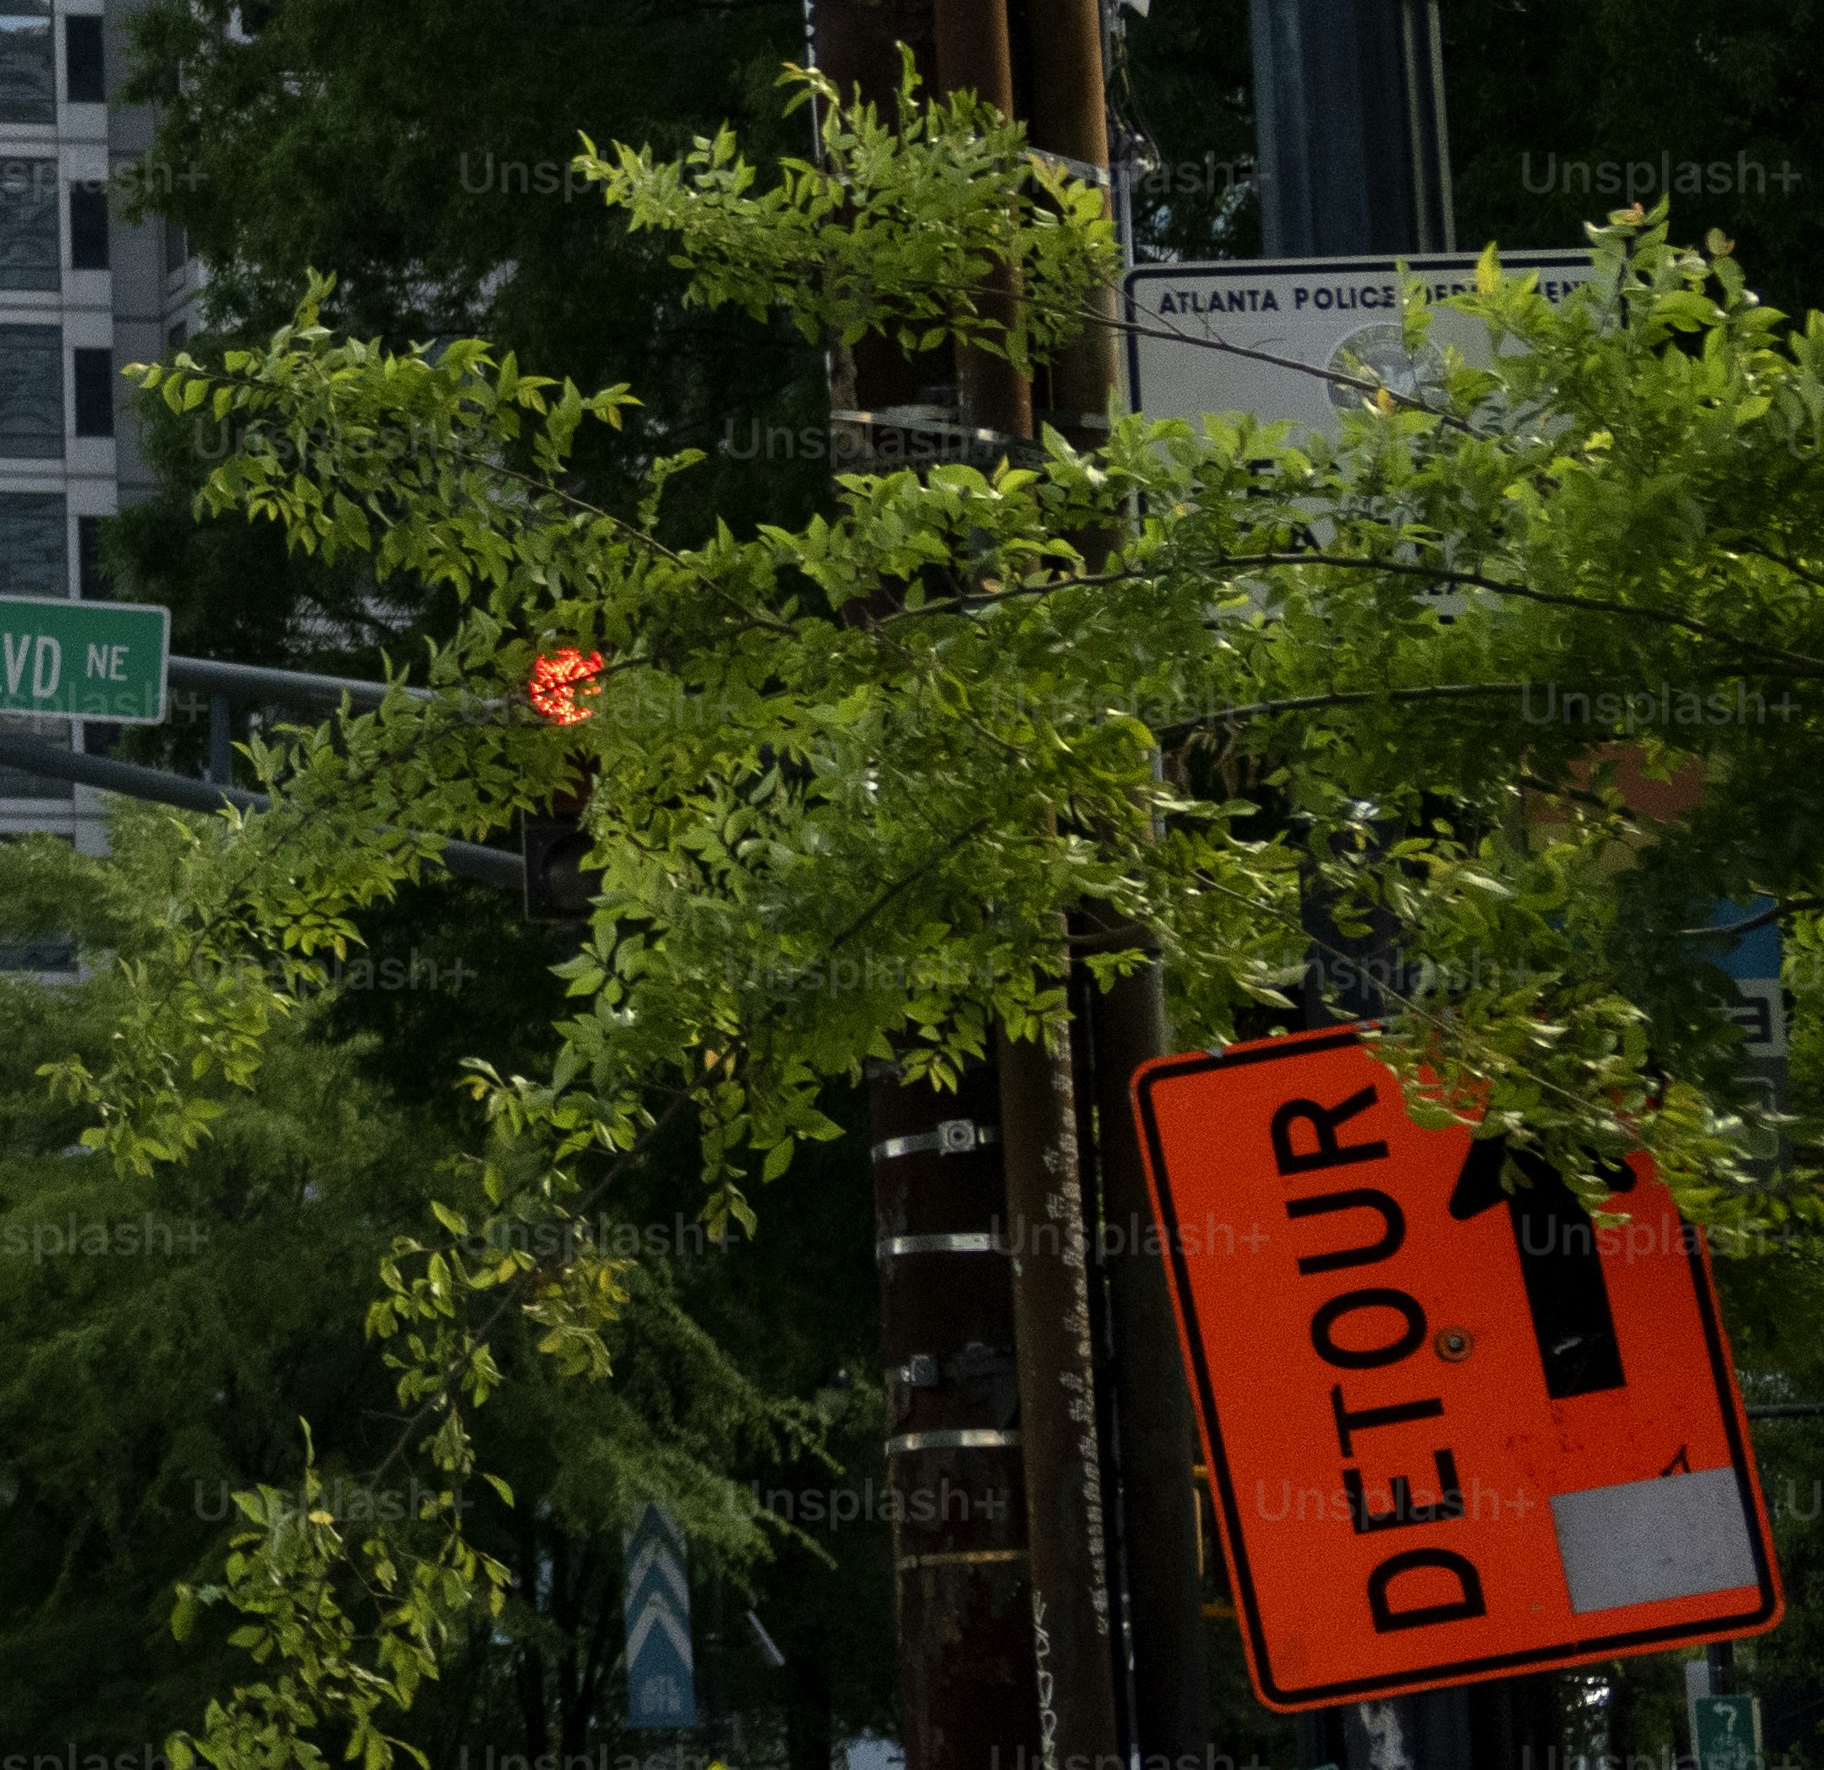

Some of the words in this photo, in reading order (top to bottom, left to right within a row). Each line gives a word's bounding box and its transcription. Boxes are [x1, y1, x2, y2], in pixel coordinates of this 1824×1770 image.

[1159, 289, 1279, 315] ATLANTA
[1295, 286, 1397, 310] POLICE
[86, 643, 130, 681] NE
[1270, 1084, 1487, 1634] DETOUR
